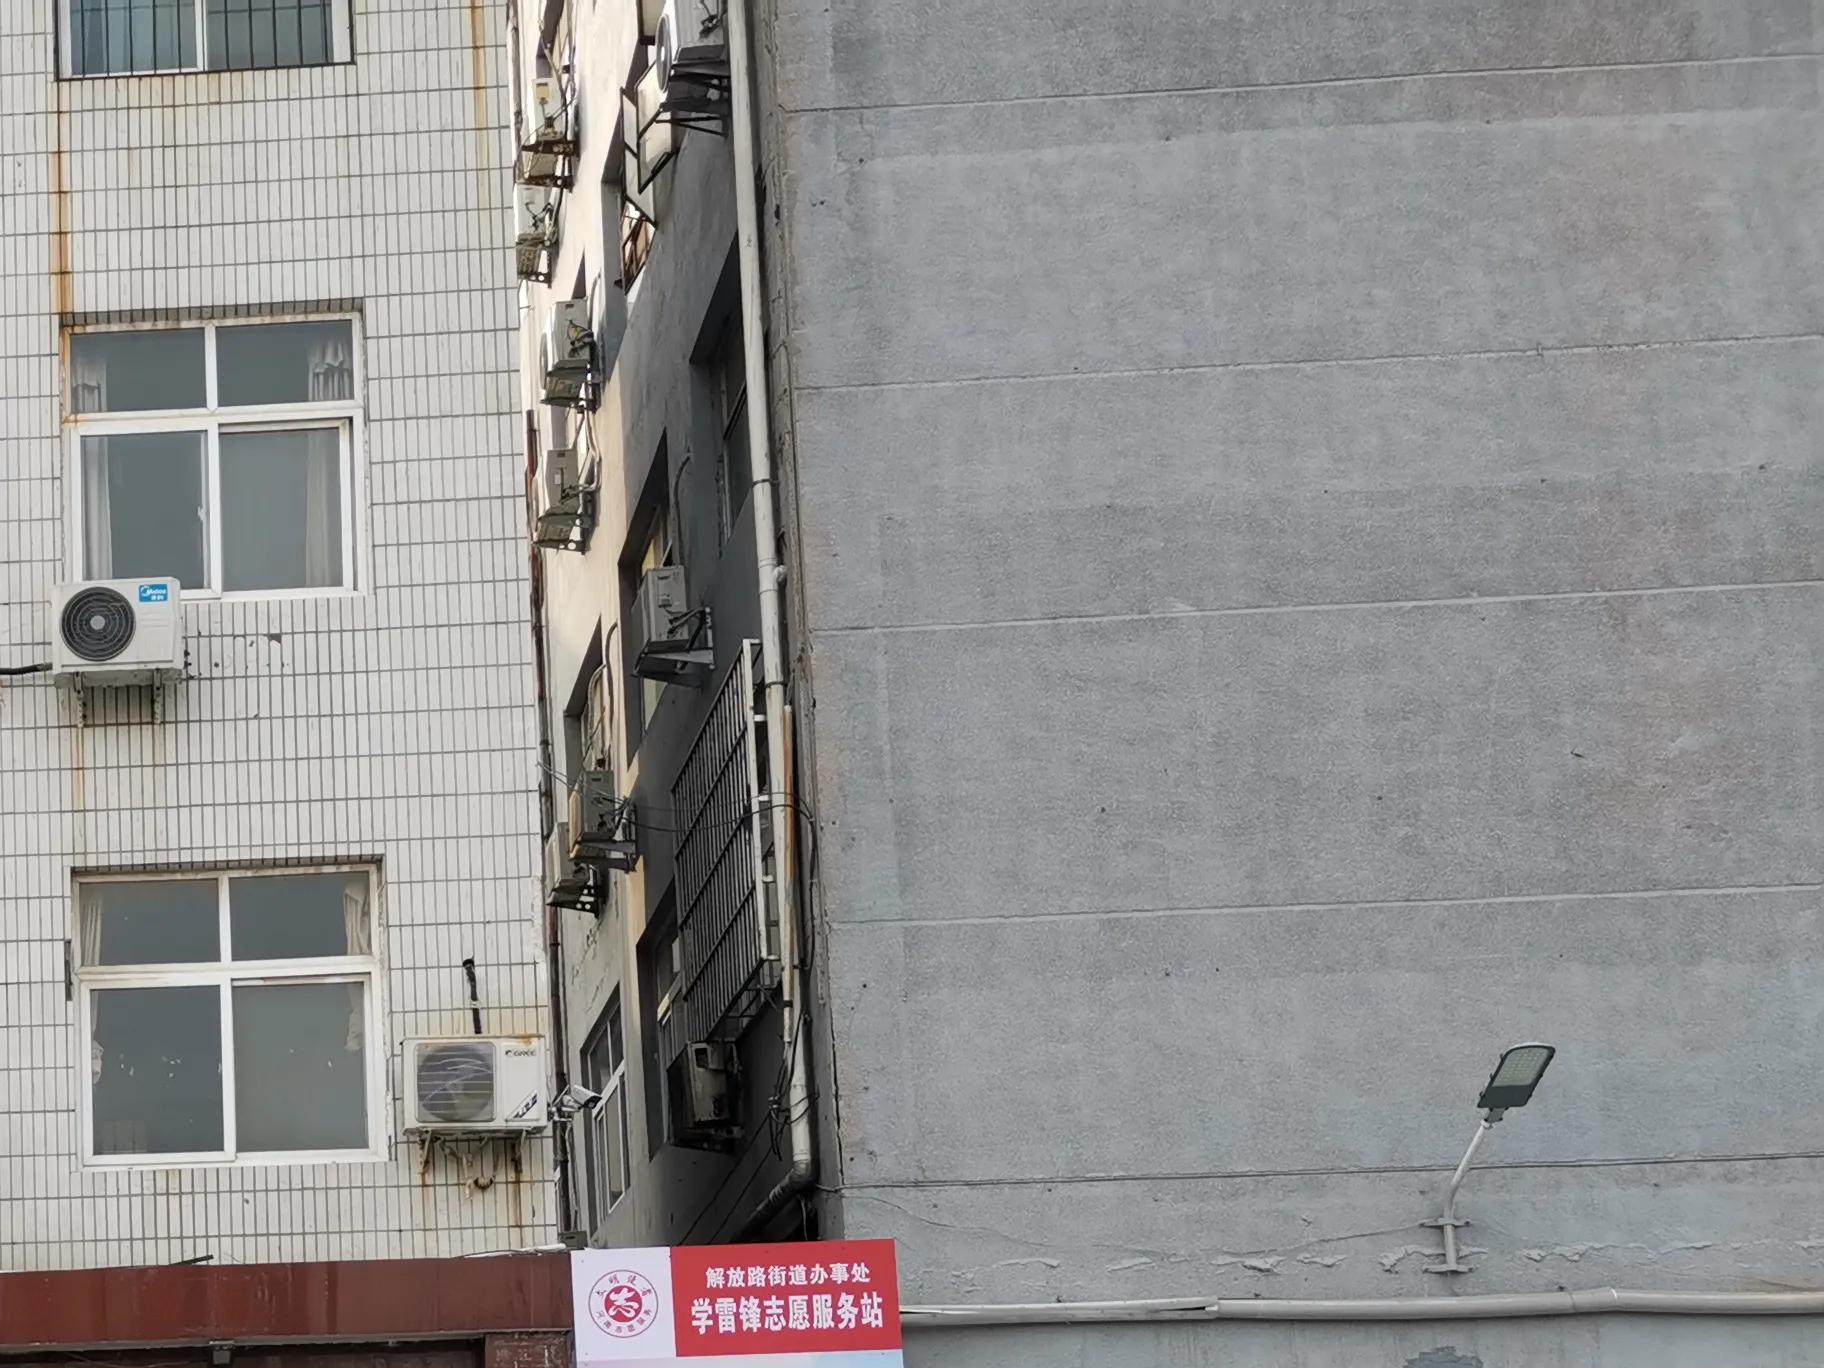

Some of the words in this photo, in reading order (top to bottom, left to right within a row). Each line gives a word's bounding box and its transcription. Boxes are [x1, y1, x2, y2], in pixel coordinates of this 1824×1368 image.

[705, 1263, 871, 1289] 解放路街道办事处
[691, 1292, 884, 1335] 学雷锋志愿服务站
